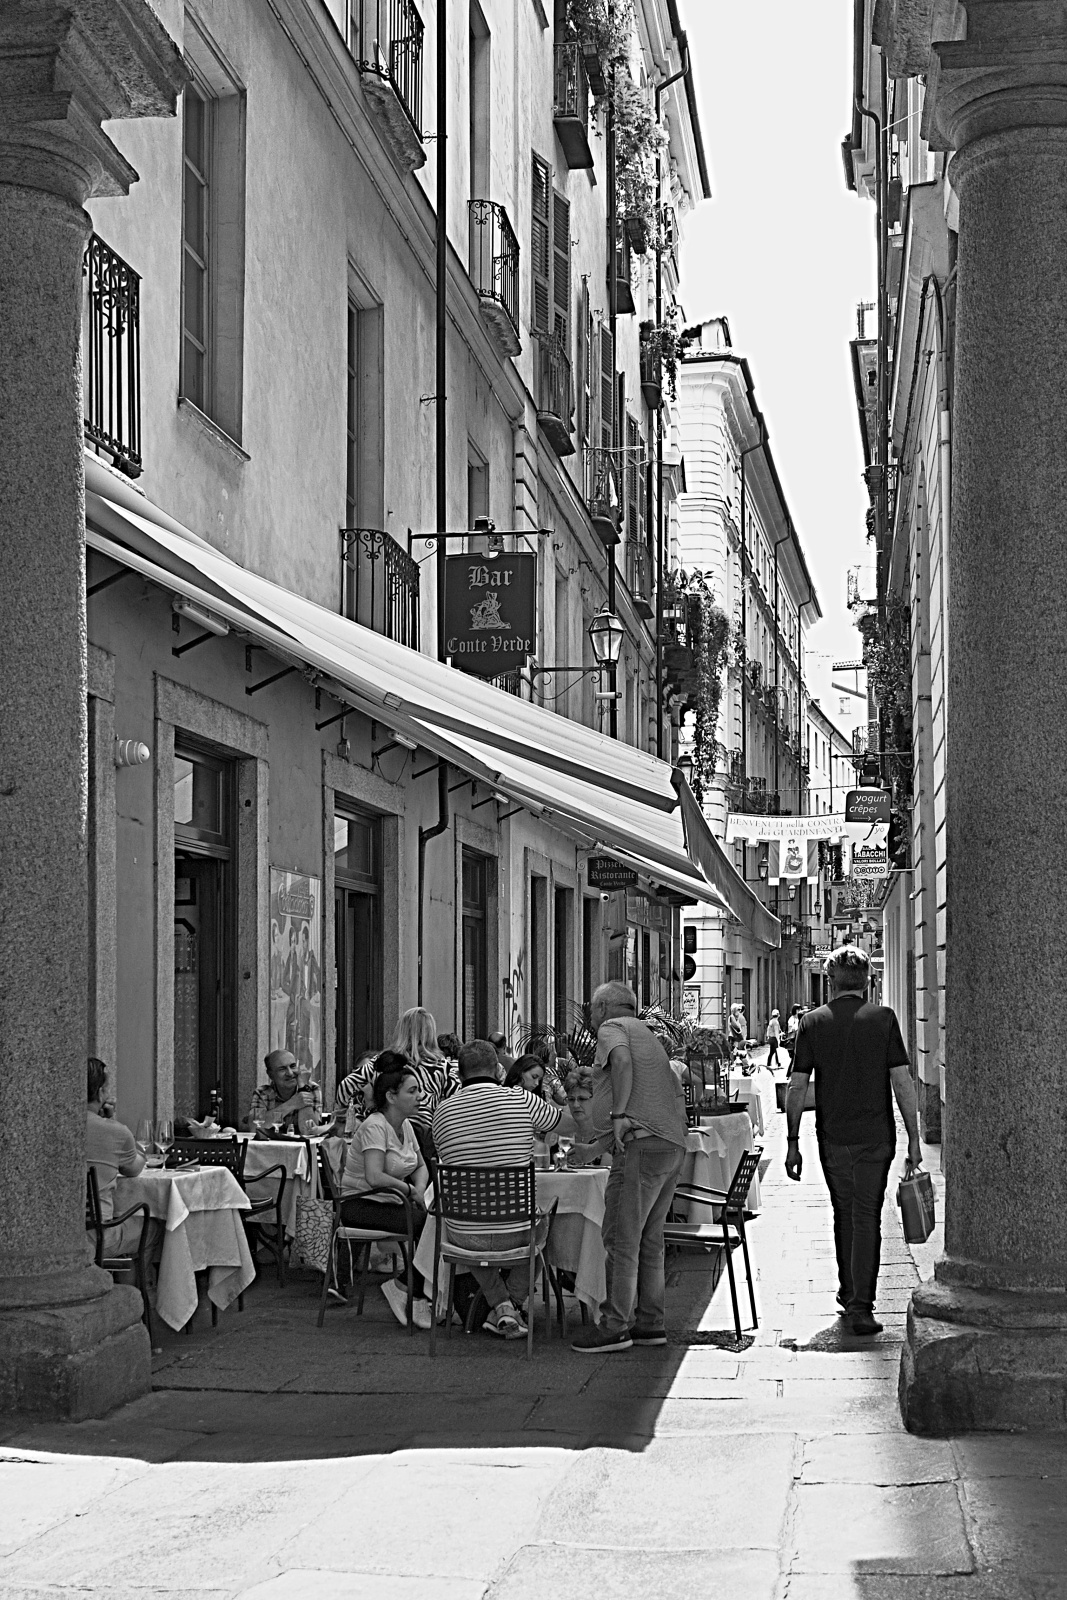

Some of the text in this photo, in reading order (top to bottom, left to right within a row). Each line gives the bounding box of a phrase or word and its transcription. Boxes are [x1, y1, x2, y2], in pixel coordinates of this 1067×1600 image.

[468, 565, 513, 590] Bar
[447, 635, 531, 653] Conte Verde
[855, 795, 887, 804] yogurt
[849, 804, 878, 814] crêpes
[730, 817, 783, 828] BENVENUTI
[786, 819, 804, 828] nella
[758, 825, 843, 837] dei GUARDINFANTI
[853, 850, 886, 858] TABACCHI
[590, 870, 636, 880] Ristorante
[853, 866, 886, 874] LOTTO
